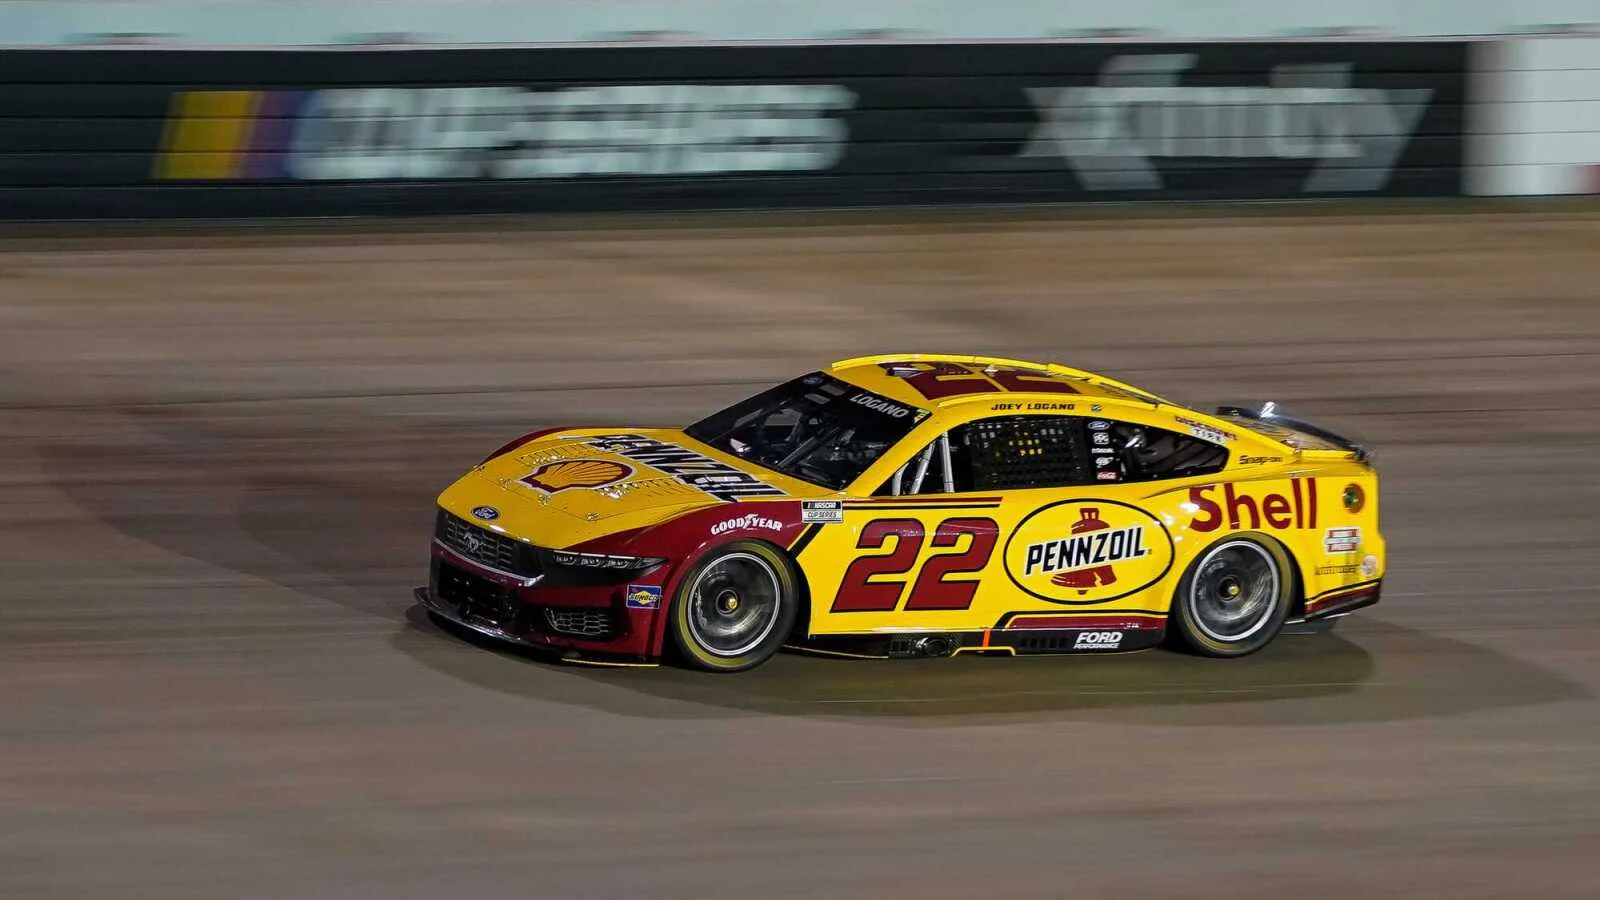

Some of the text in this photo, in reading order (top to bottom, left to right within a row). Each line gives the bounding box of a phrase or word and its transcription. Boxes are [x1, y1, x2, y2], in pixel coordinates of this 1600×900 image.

[849, 393, 909, 418] LOGANO
[991, 403, 1075, 411] JOEY LOGANO
[1189, 477, 1317, 532] Shell
[829, 517, 1000, 613] 22
[1025, 527, 1146, 576] PENNZOIL
[1076, 632, 1122, 643] FORD
